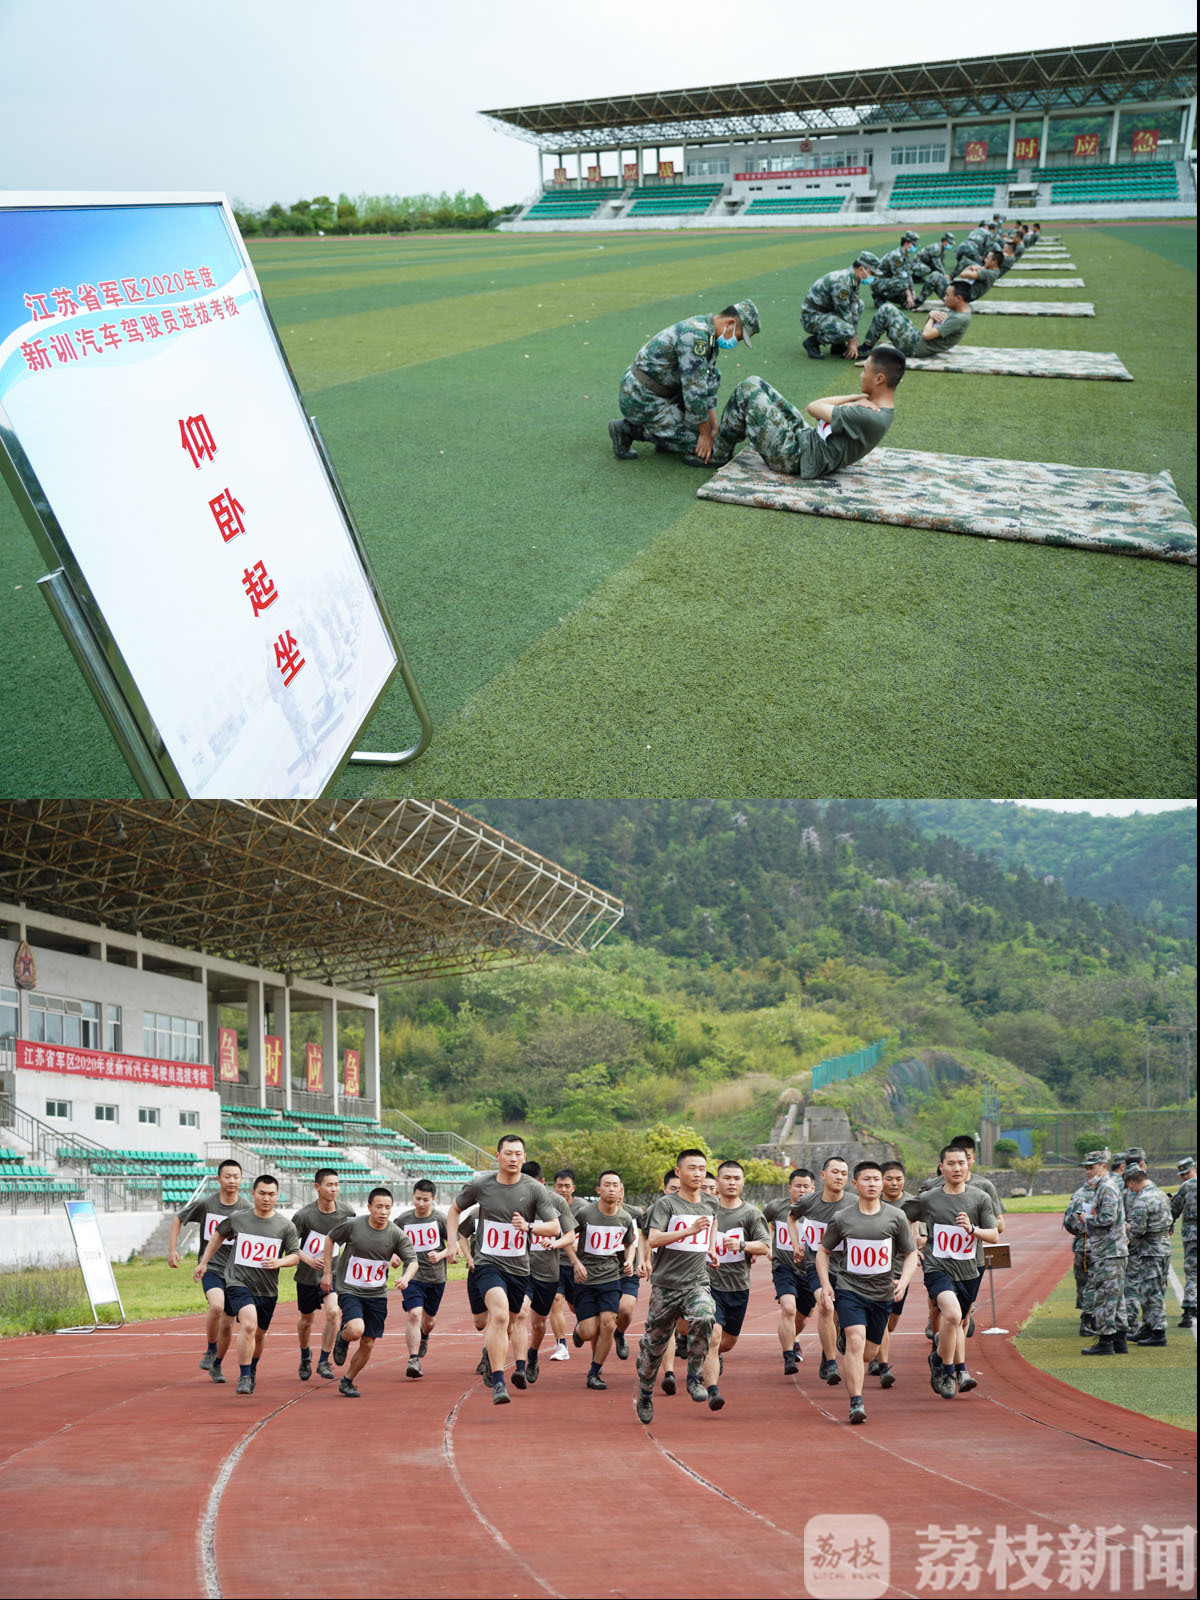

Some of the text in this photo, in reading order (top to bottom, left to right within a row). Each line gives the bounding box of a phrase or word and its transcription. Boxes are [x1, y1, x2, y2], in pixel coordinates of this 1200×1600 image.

[24, 266, 217, 322] 江苏省军区2020年度
[20, 295, 240, 372] 新训汽车驾驶员选拔考核
[178, 413, 306, 687] 仰卧起坐
[221, 1031, 238, 1078] 急
[265, 1040, 282, 1084] 时
[309, 1047, 322, 1088] 应
[346, 1054, 358, 1093] 急
[241, 1240, 277, 1261] 020
[406, 1227, 437, 1247] 019
[487, 1227, 525, 1250] 016
[590, 1231, 623, 1249] 012
[937, 1231, 975, 1254] 002
[851, 1245, 889, 1268] 008
[352, 1262, 385, 1283] 018
